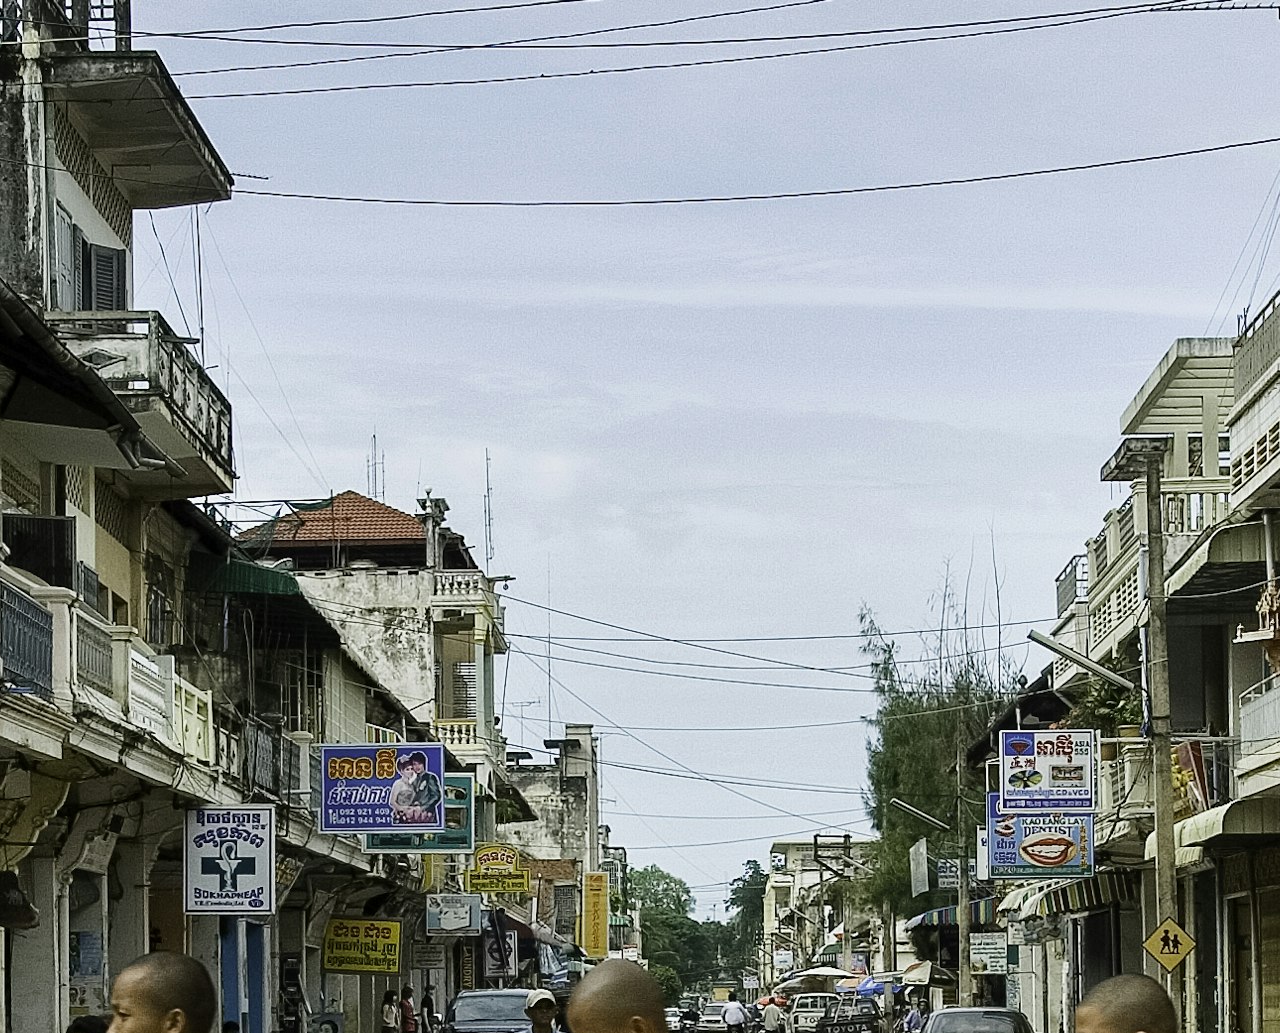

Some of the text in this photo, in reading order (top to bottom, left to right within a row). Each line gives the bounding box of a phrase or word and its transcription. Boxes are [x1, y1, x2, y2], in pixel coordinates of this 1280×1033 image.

[1067, 817, 1085, 825] LAY
[1024, 826, 1073, 837] DENTIST
[463, 946, 473, 988] LAUNDRY
[826, 1024, 867, 1033] TOYOTA
